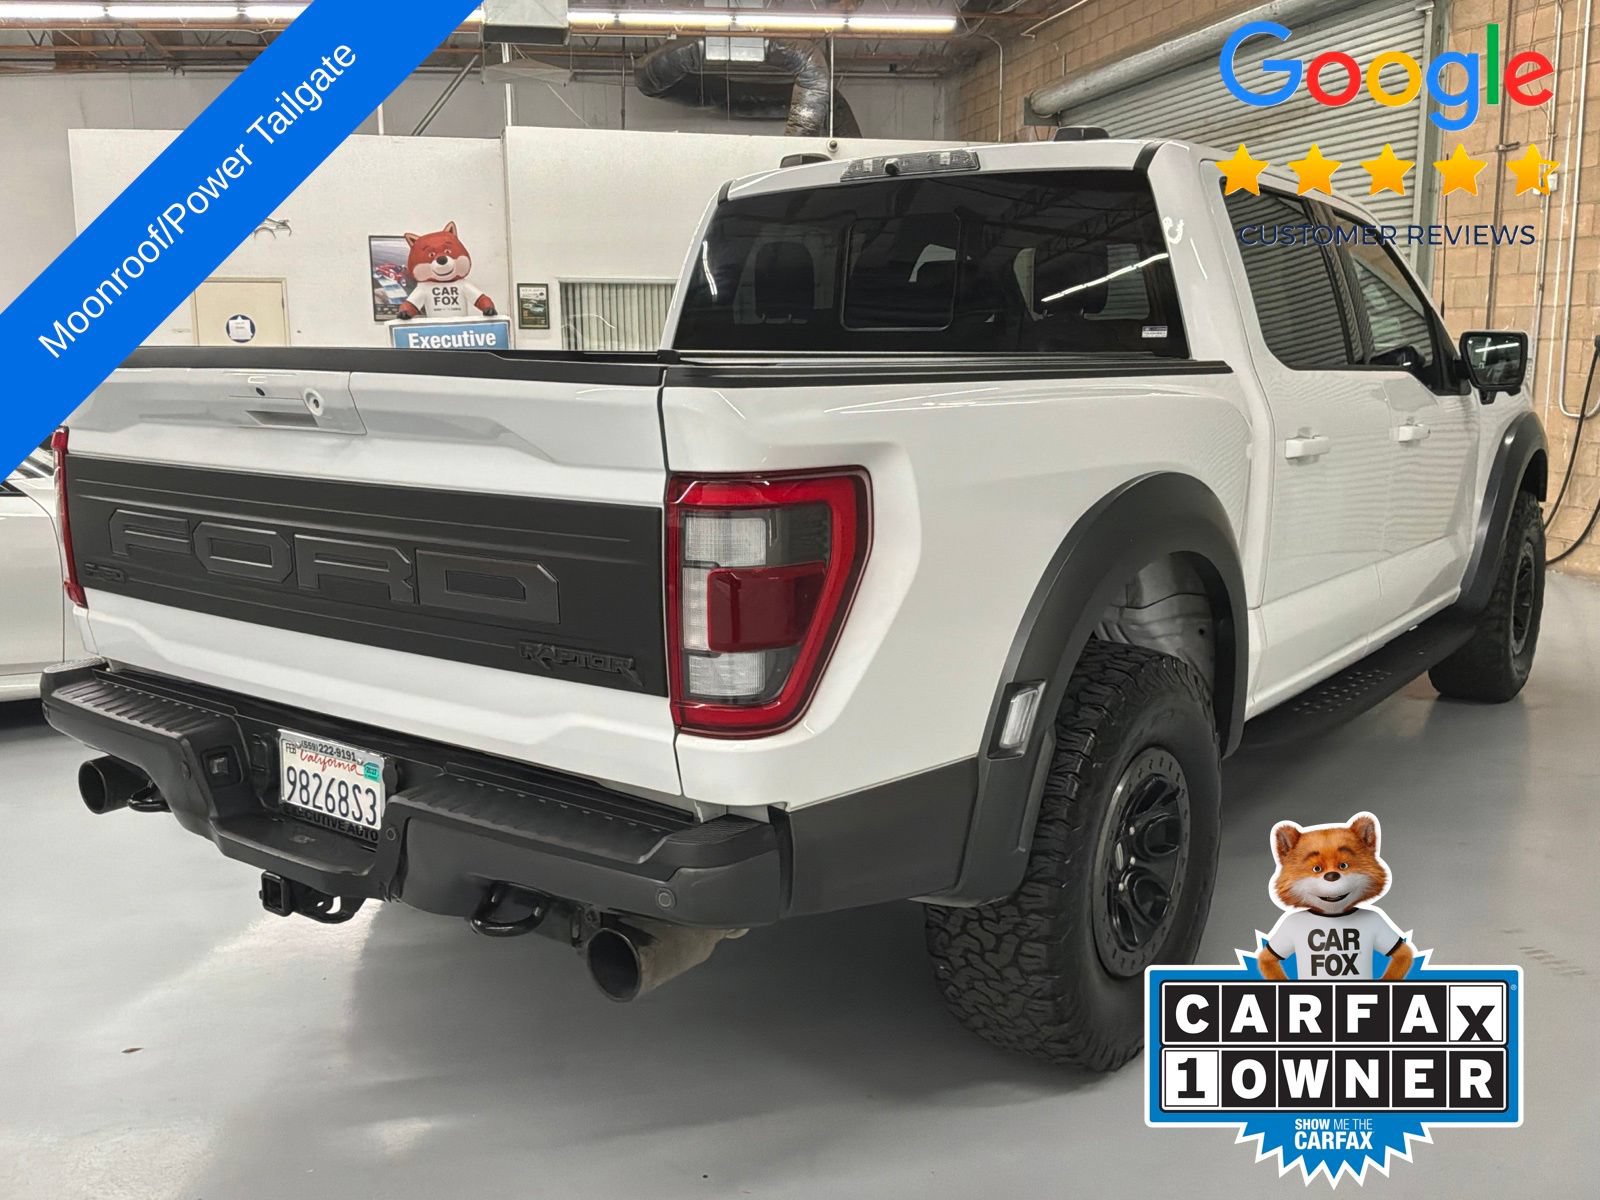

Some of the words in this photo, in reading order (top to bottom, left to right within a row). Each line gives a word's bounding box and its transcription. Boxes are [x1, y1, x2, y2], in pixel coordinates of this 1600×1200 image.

[432, 287, 459, 296] CAR
[433, 296, 460, 306] FOX
[408, 330, 496, 349] Executive
[108, 508, 561, 625] FORD
[518, 639, 645, 688] RAPTOR
[319, 743, 357, 762] 222-9191
[287, 766, 377, 826] 98268S3
